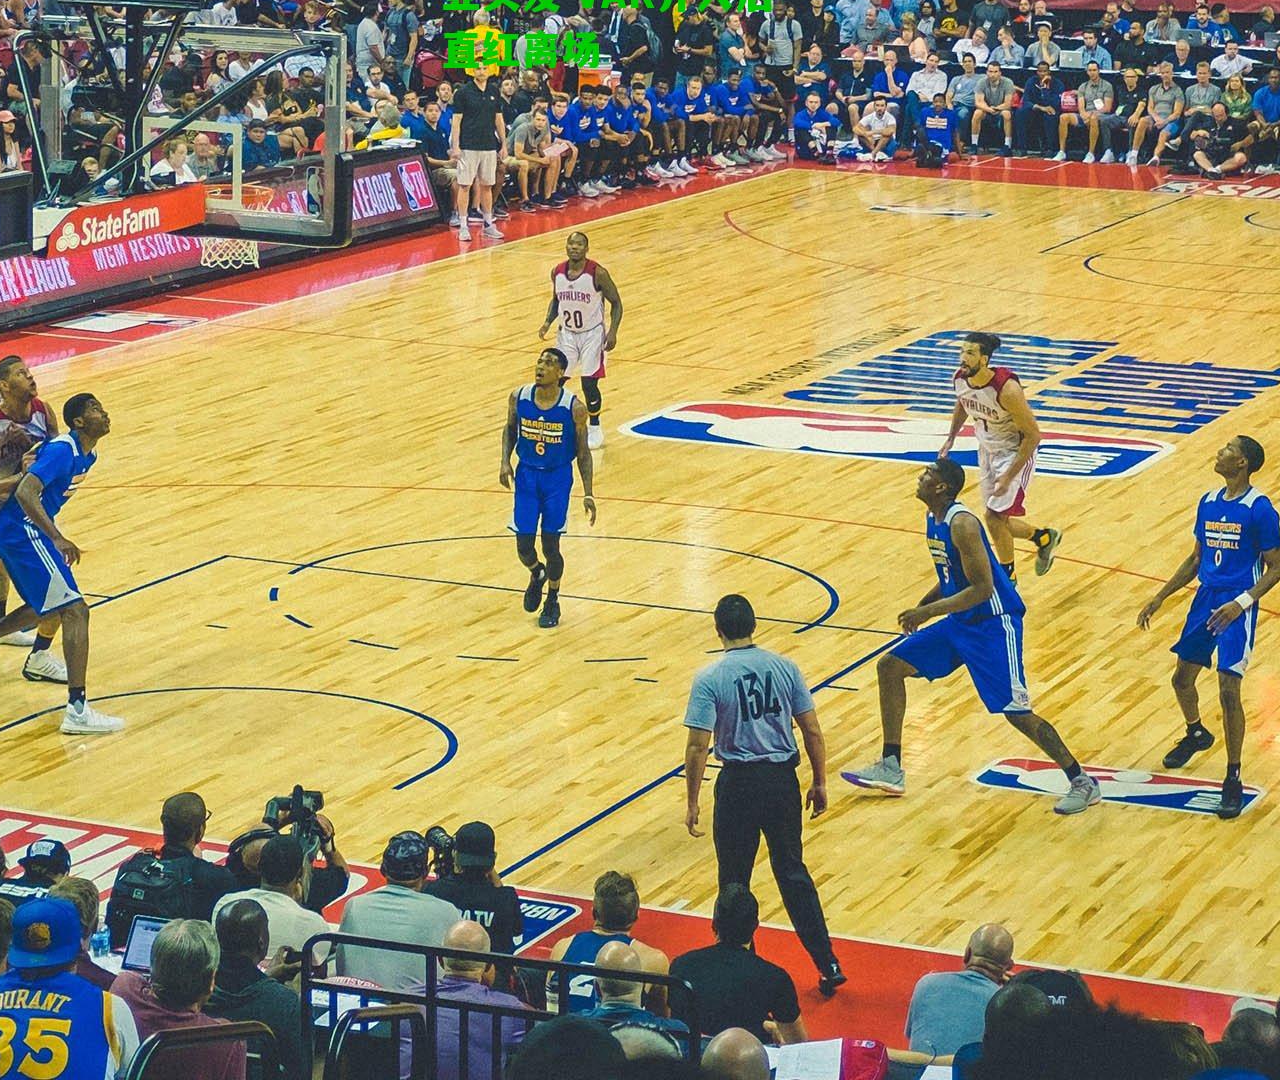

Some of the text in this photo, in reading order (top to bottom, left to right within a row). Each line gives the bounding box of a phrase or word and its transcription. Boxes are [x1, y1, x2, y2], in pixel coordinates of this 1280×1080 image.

[357, 171, 402, 219] LEAGUE
[92, 233, 192, 271] MGM RESORTS
[17, 256, 77, 296] LEAGUE
[563, 309, 584, 329] 20
[521, 417, 564, 431] WARRIORS
[535, 441, 546, 455] 6
[1214, 549, 1223, 567] 0
[733, 670, 782, 723] 134
